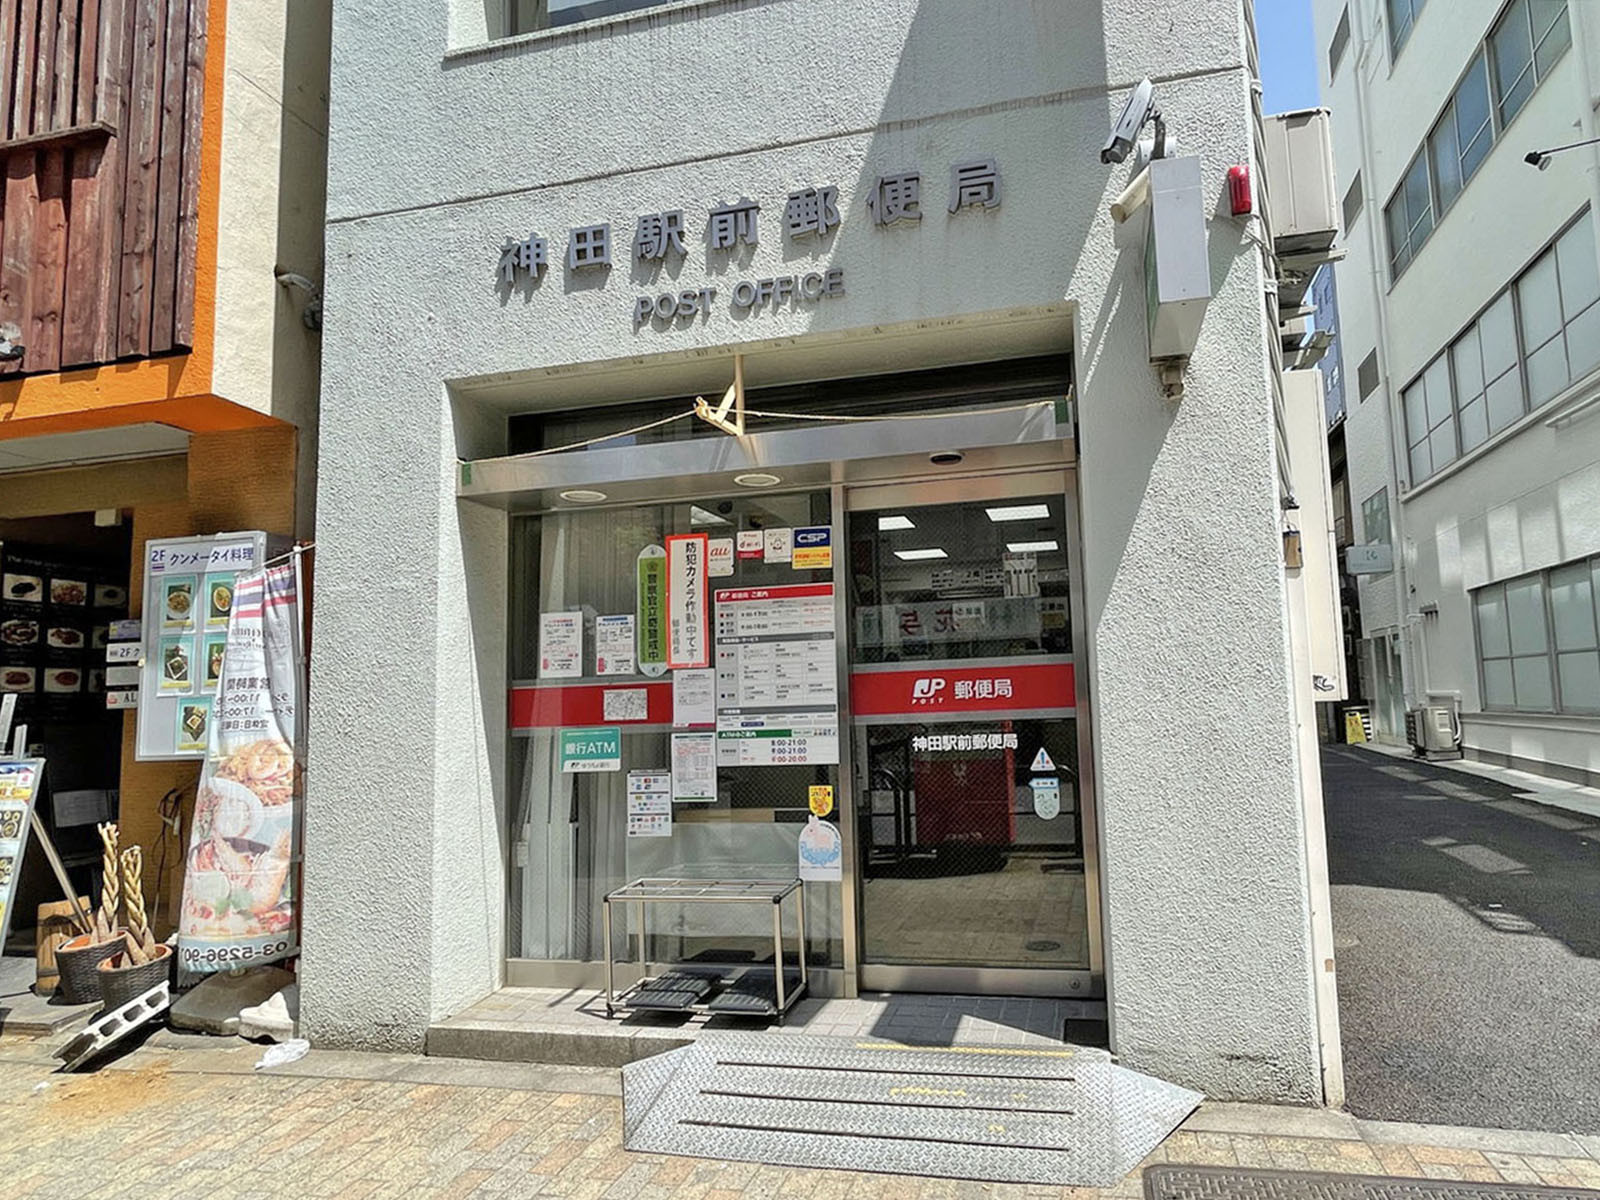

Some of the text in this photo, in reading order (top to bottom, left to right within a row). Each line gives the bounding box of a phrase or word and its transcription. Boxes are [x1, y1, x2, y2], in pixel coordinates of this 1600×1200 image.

[500, 158, 1001, 283] 神田駅前郵便局
[634, 267, 844, 322] POST OFFICE
[797, 532, 827, 543] CSP
[151, 547, 255, 567] 2F クンメータイ料理
[710, 547, 730, 557] au
[954, 679, 1012, 699] 郵便局
[565, 741, 616, 755] 銀行ATM
[912, 733, 1018, 752] 神田駅前郵便局
